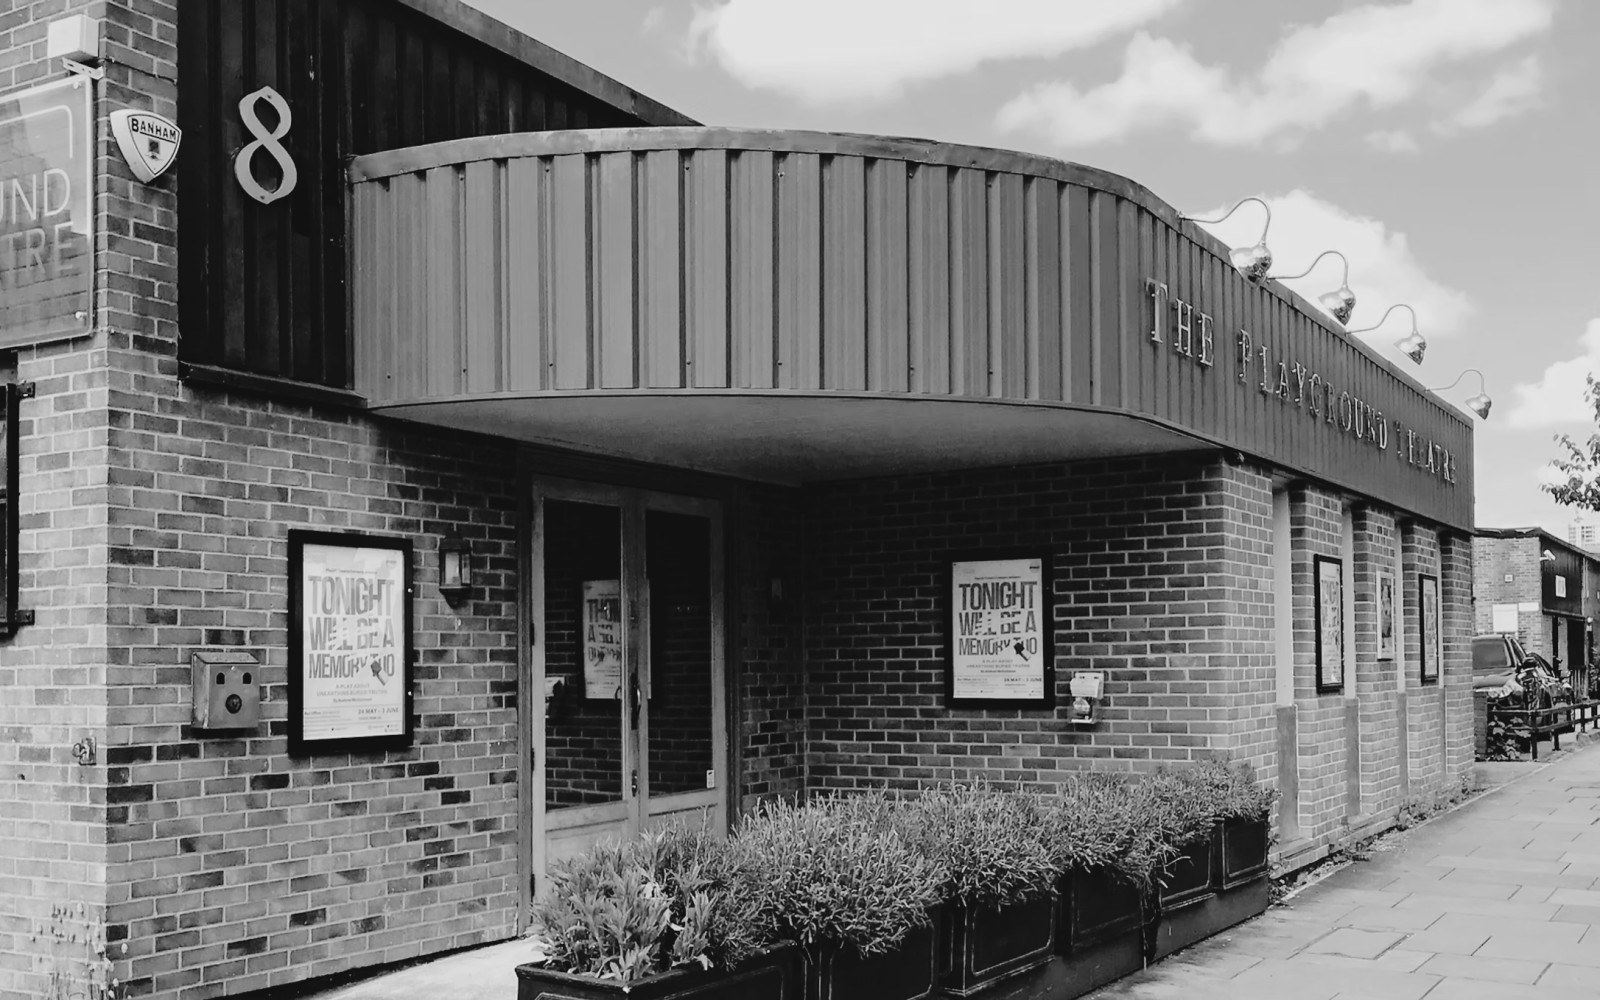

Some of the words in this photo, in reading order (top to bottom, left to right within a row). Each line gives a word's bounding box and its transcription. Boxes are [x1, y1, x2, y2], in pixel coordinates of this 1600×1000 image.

[131, 117, 176, 141] BANHAM
[234, 85, 298, 204] 8
[1144, 276, 1214, 367] THE
[1238, 329, 1387, 450] PLAYGROUND
[308, 575, 395, 616] TONIGHT
[958, 581, 1038, 610] TONIGHT
[383, 618, 395, 648] A
[1025, 611, 1037, 633] A
[959, 637, 1011, 655] MEMORY
[308, 653, 368, 679] MEMORY
